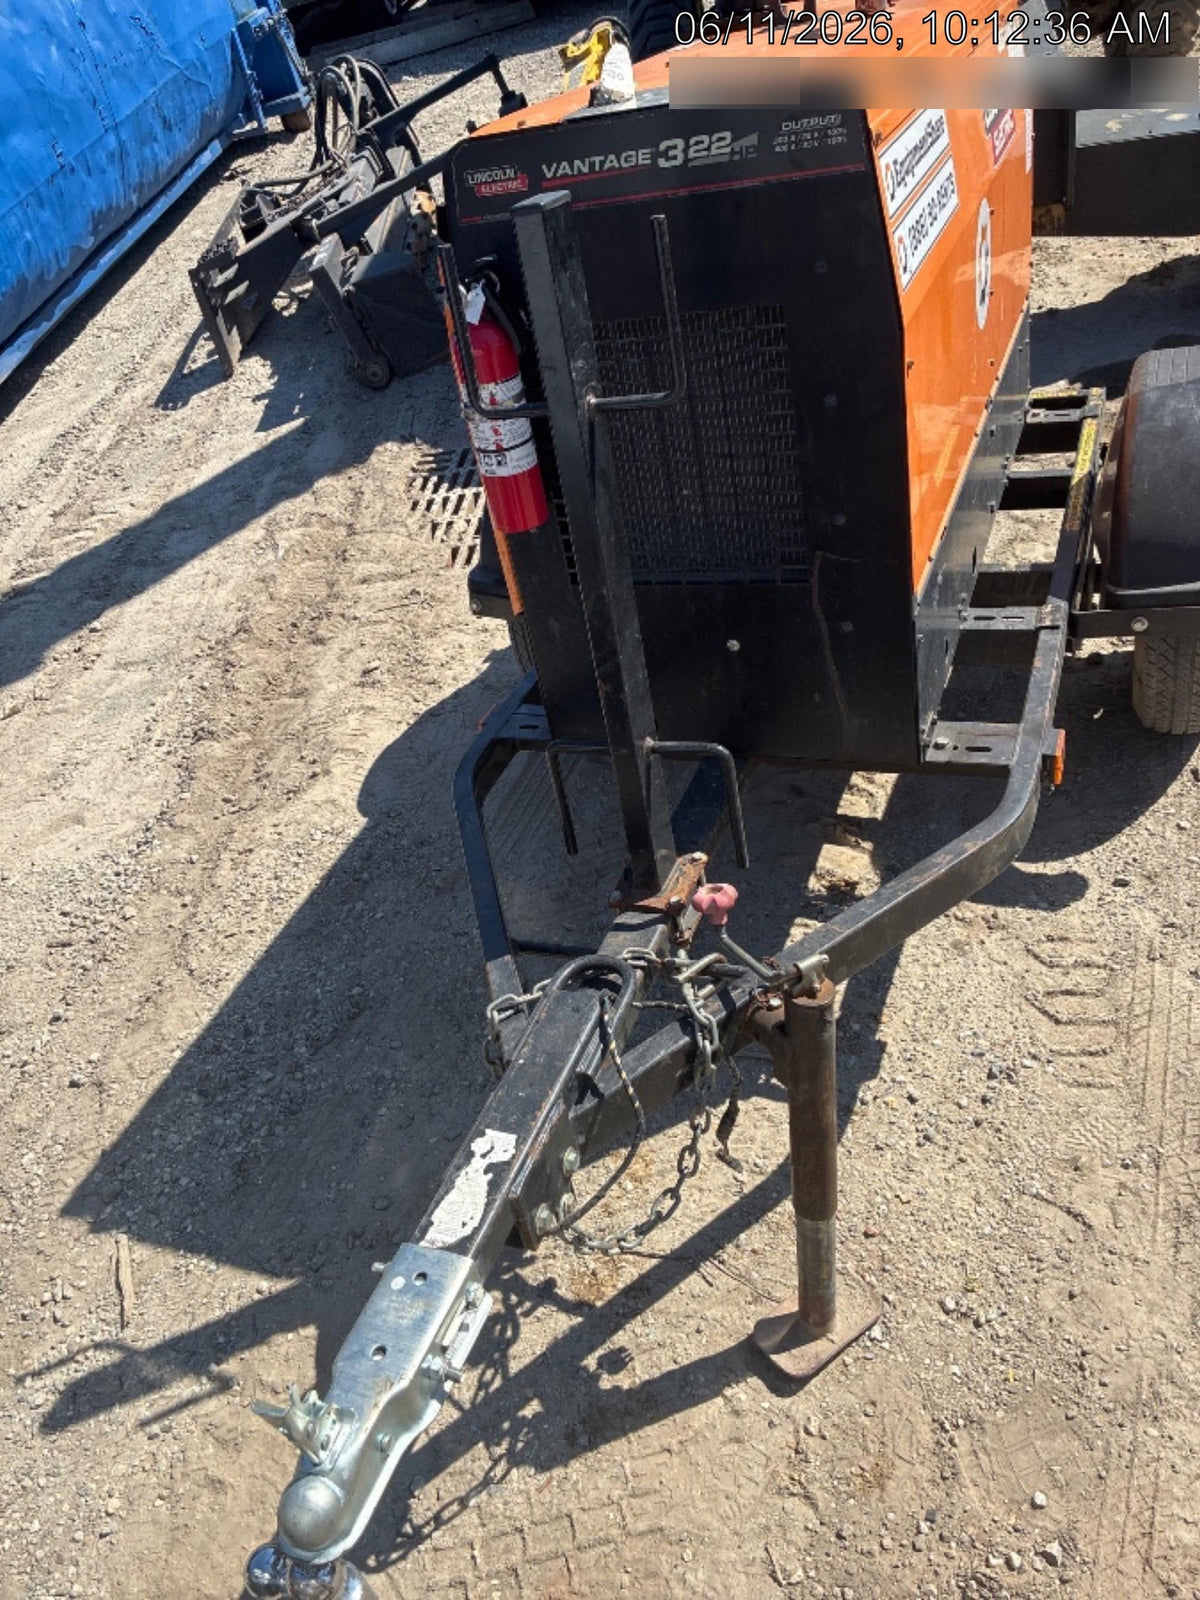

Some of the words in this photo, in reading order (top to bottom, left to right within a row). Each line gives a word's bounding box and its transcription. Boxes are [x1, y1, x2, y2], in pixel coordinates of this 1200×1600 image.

[781, 114, 838, 131] OUTPUT
[541, 147, 652, 178] VANTAGE
[657, 130, 732, 168] 322
[467, 168, 515, 184] LINCOLN
[481, 180, 524, 192] ELECTRIC
